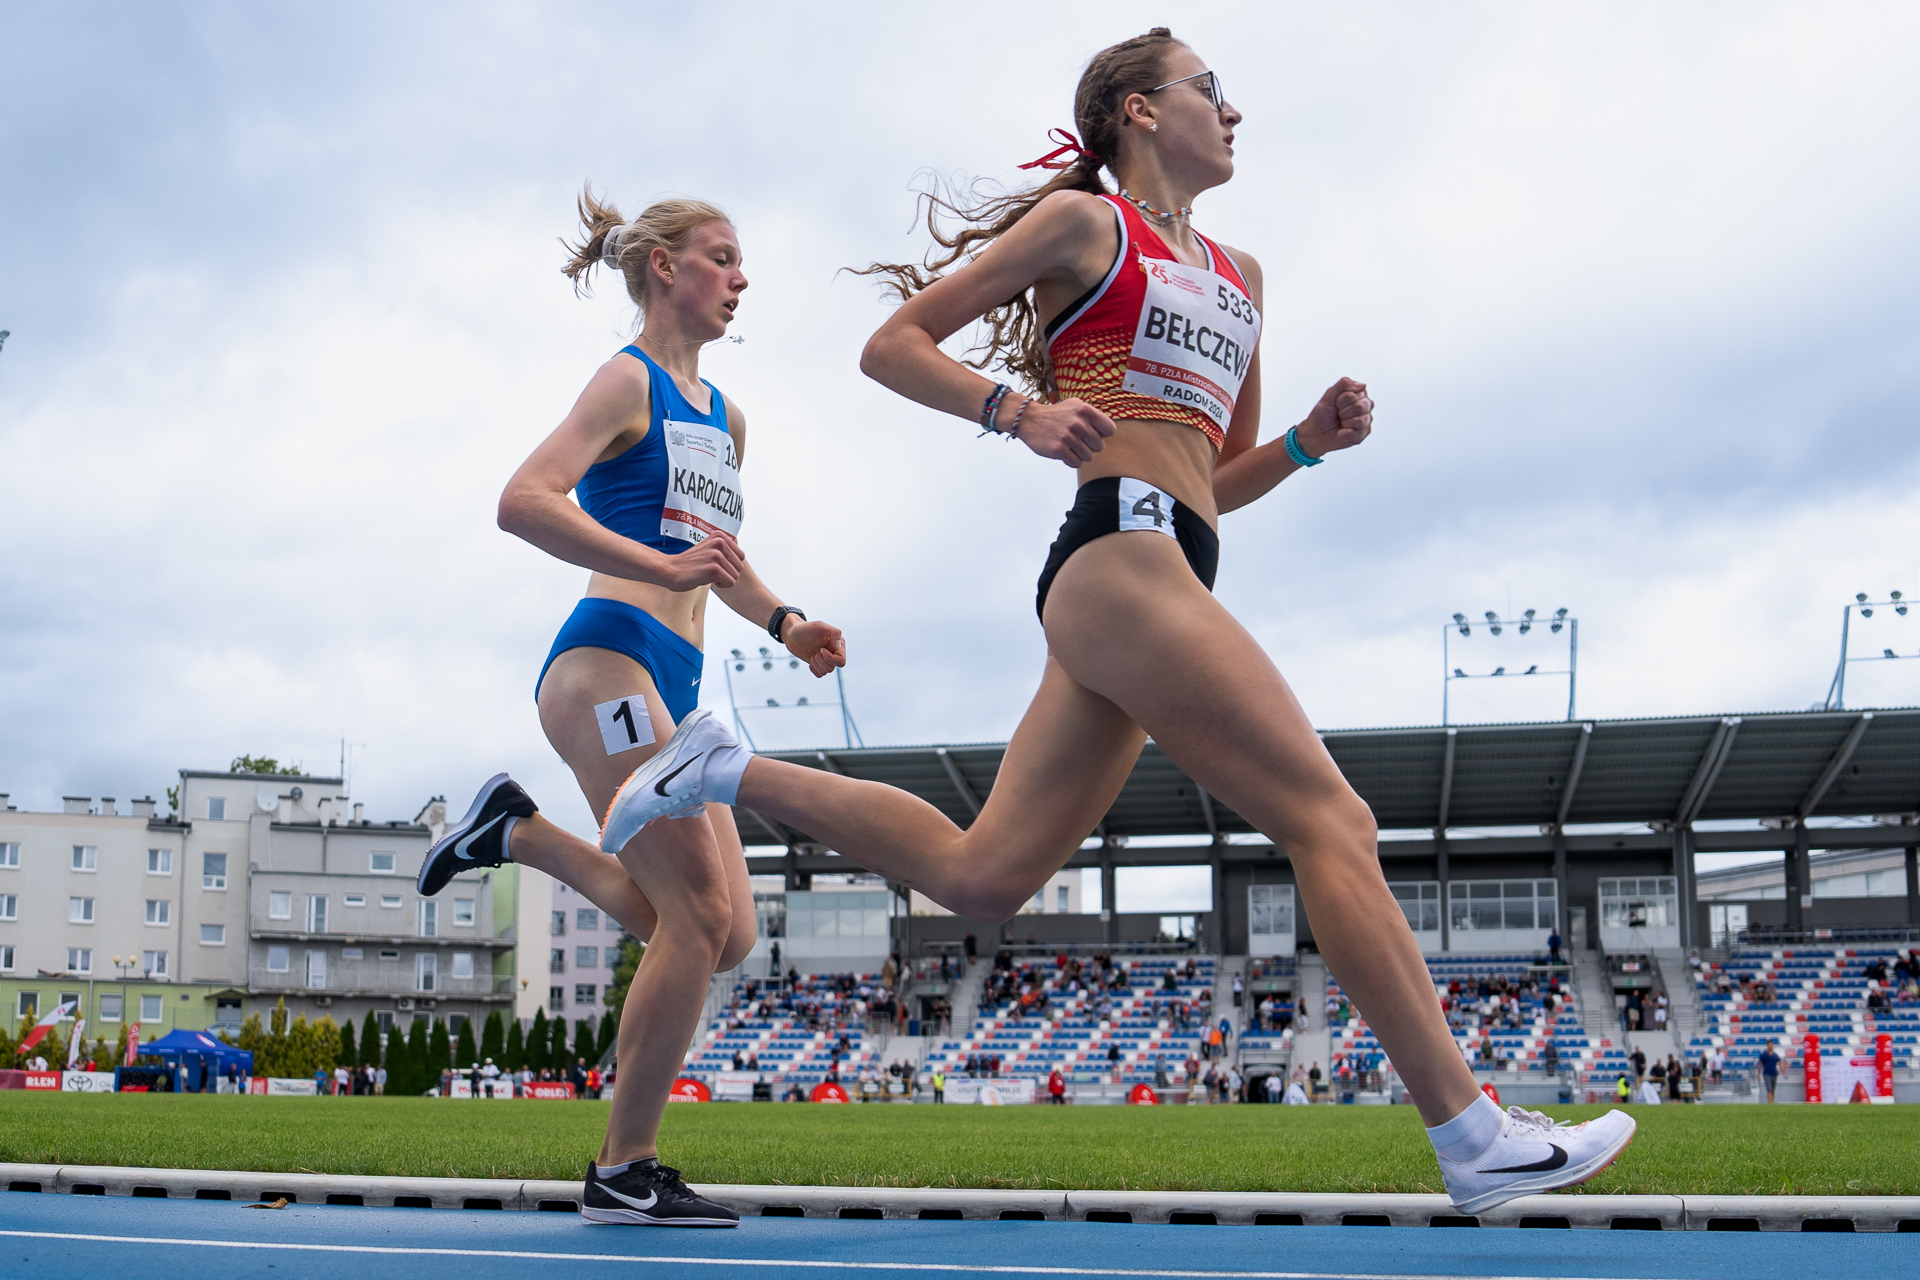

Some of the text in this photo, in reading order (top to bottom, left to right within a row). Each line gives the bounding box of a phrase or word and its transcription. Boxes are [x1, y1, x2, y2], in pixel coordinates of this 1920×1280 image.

[1217, 284, 1254, 325] 533
[1144, 305, 1250, 381] BEŁCZEW
[1145, 363, 1159, 374] 78.
[1160, 368, 1181, 380] PZLA
[1163, 384, 1209, 407] RADOM
[1132, 490, 1167, 528] 4
[612, 700, 639, 745] 1
[26, 1077, 56, 1088] RLEN
